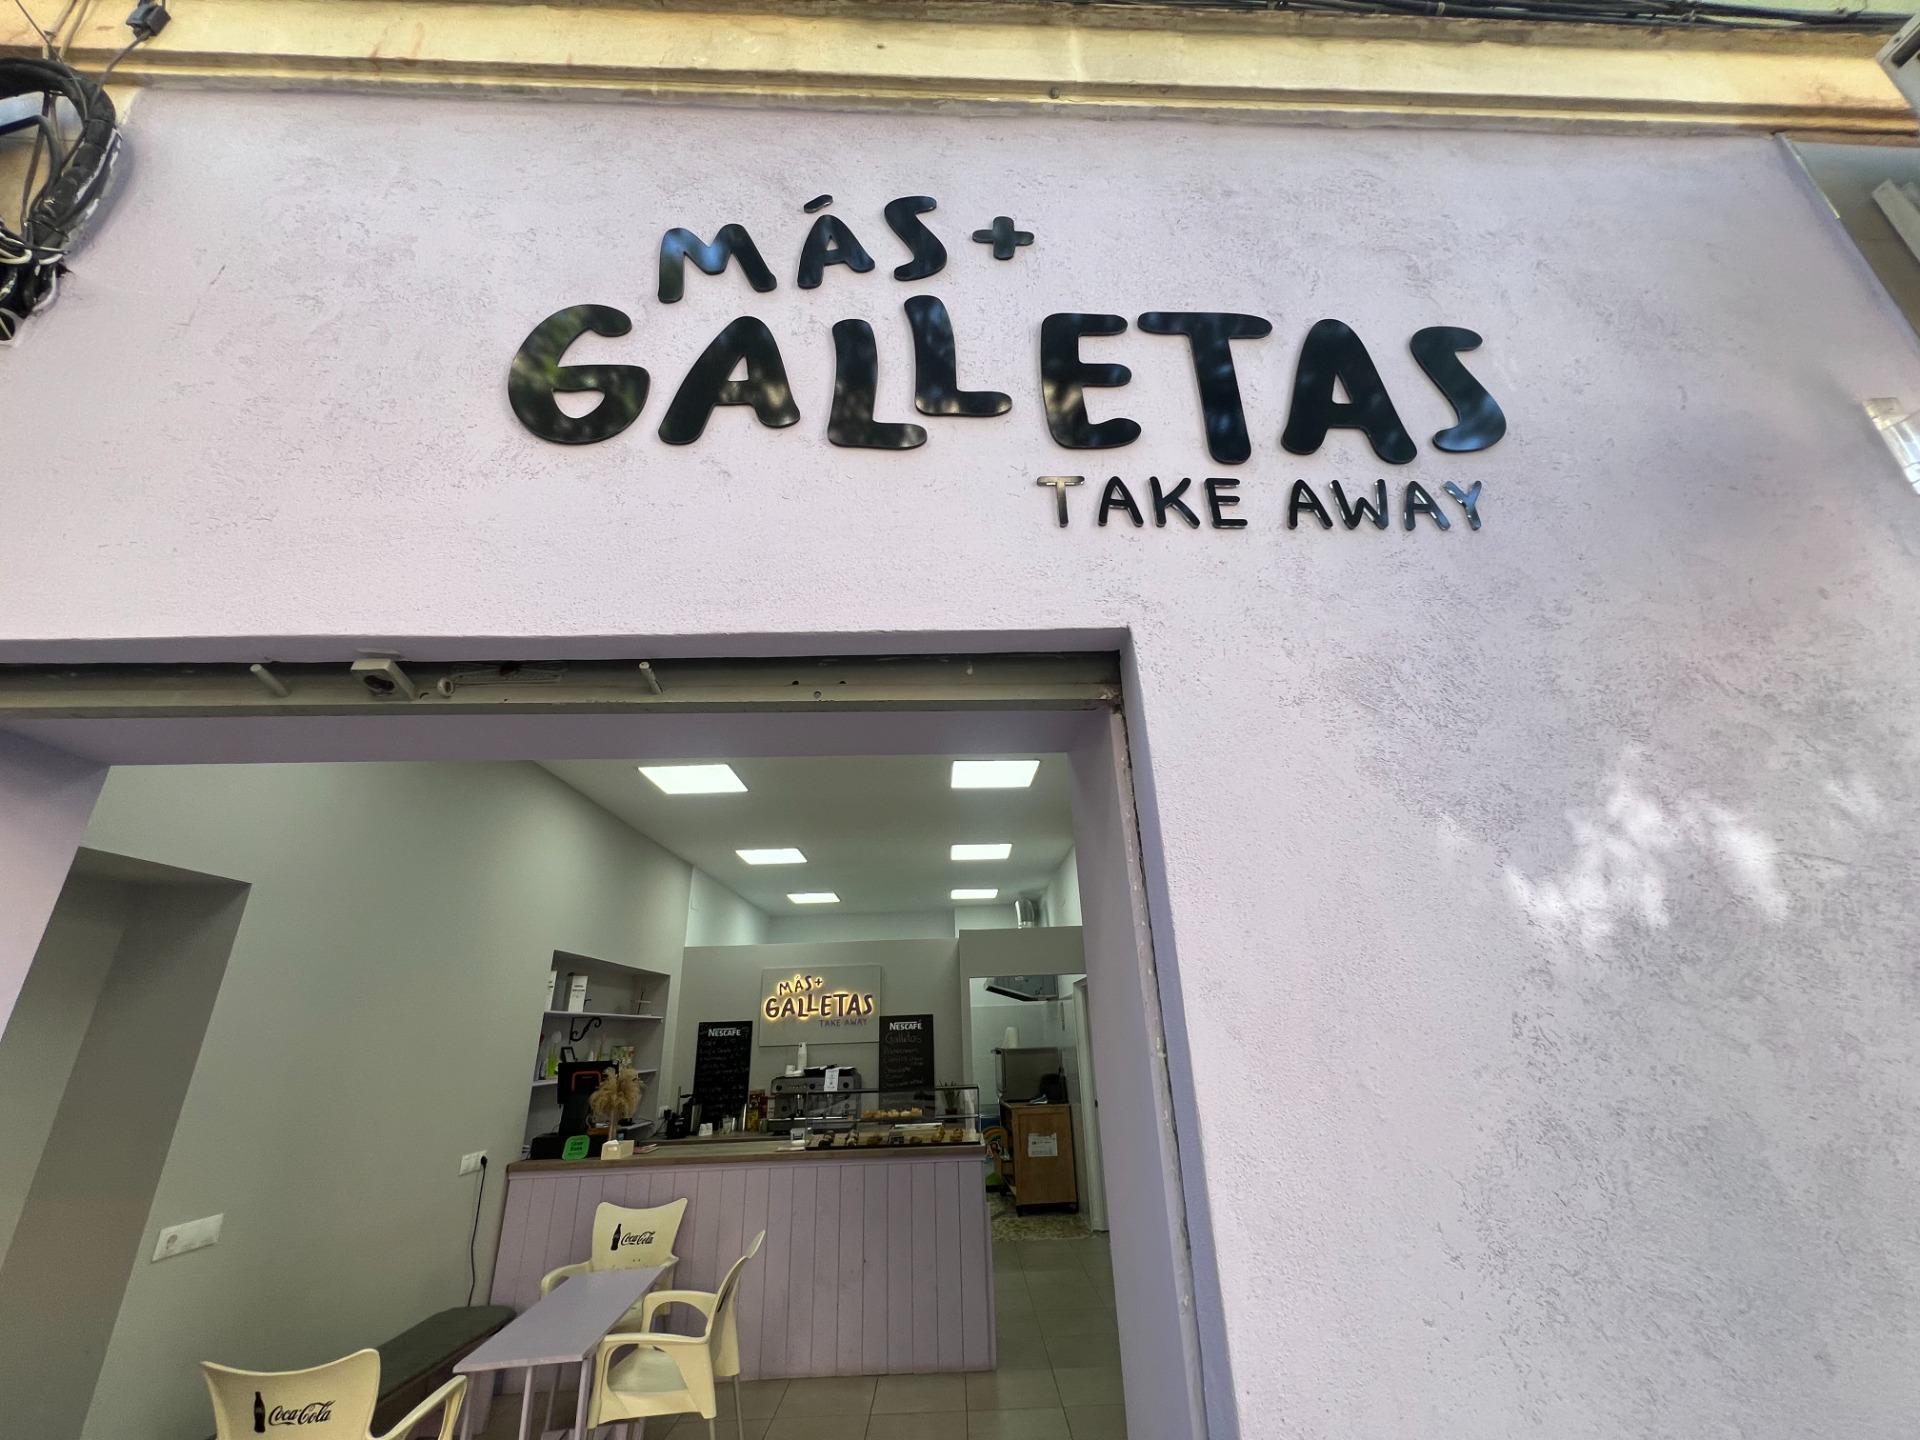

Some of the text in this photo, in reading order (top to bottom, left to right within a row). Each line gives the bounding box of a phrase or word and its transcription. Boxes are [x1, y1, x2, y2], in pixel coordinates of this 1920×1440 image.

[508, 295, 1507, 465] GALLETAS
[1037, 476, 1482, 531] TAKE AWAY
[765, 993, 873, 1018] GALLETAS
[820, 1018, 868, 1028] TAKE AWAY
[268, 1400, 336, 1426] Coca-Cola
